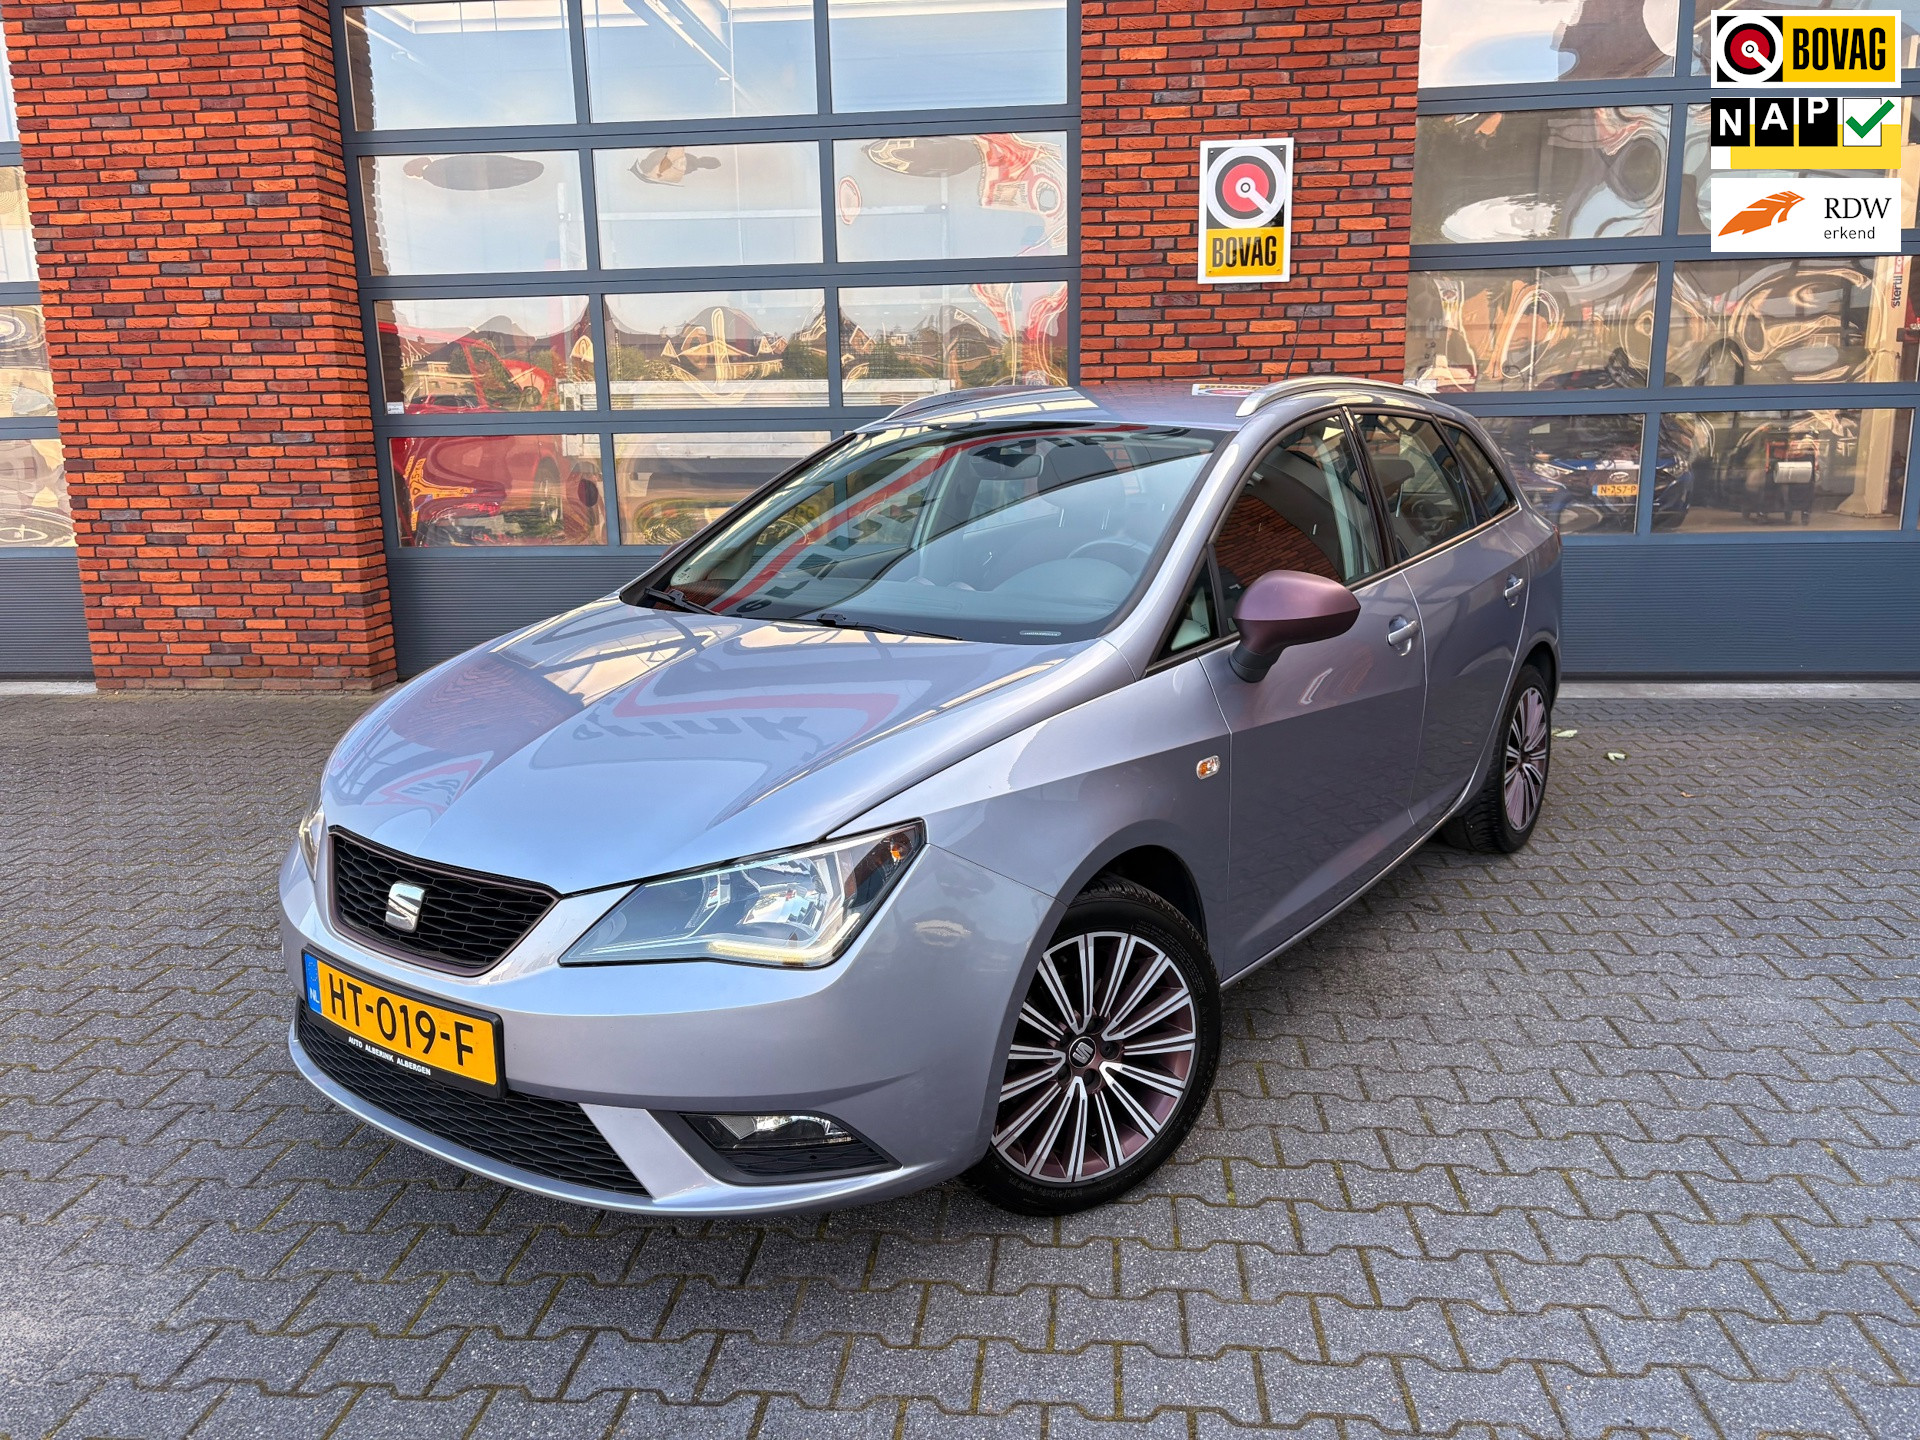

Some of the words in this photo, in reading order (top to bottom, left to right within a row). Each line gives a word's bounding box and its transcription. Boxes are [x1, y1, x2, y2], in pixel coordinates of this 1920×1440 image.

[1211, 235, 1277, 268] BOVAG
[1891, 275, 1903, 307] stertil
[309, 987, 320, 1004] NL
[328, 973, 474, 1067] HT-019-F
[348, 1036, 363, 1049] AUTO
[364, 1044, 395, 1063] ALBERINK
[396, 1057, 431, 1076] ALBERGEN
